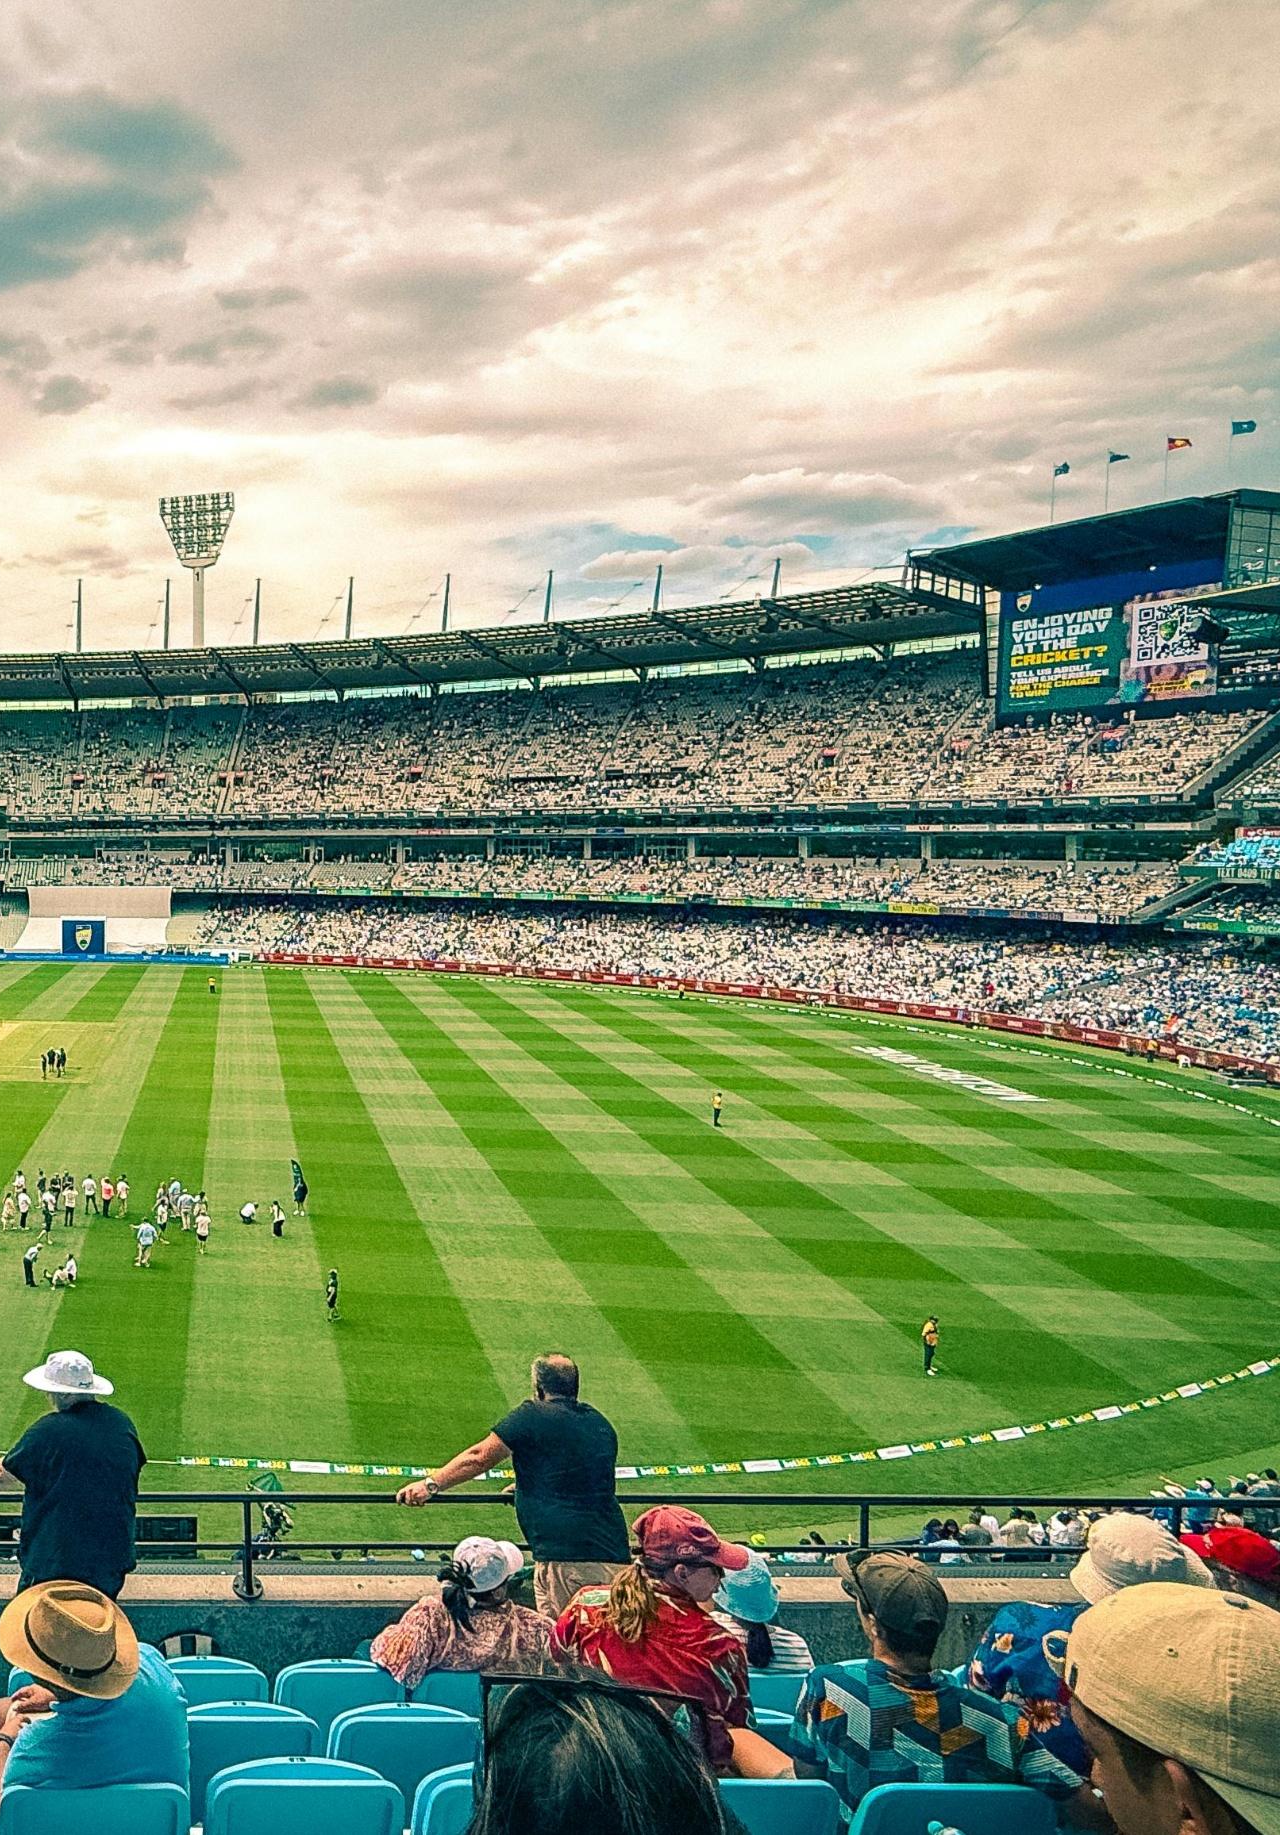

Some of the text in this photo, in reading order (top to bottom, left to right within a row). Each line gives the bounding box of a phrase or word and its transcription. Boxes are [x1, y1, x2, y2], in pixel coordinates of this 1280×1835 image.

[1012, 607, 1113, 632] ENJOYING
[1012, 620, 1110, 643] YOUR DAY
[1011, 637, 1078, 656] AT THE
[1010, 645, 1108, 667] CRICKET?
[1010, 663, 1092, 679] TELL US ABOUT
[1054, 677, 1101, 688] CHANCE
[1217, 868, 1235, 878] TEXT
[1237, 868, 1257, 879] 0409
[1260, 868, 1273, 879] 117
[1183, 920, 1219, 930] bet365
[181, 1457, 210, 1465] bet365
[219, 1458, 249, 1467] bet365
[257, 1459, 287, 1469] bet365
[334, 1464, 364, 1474] bet365
[373, 1466, 403, 1475] bet365
